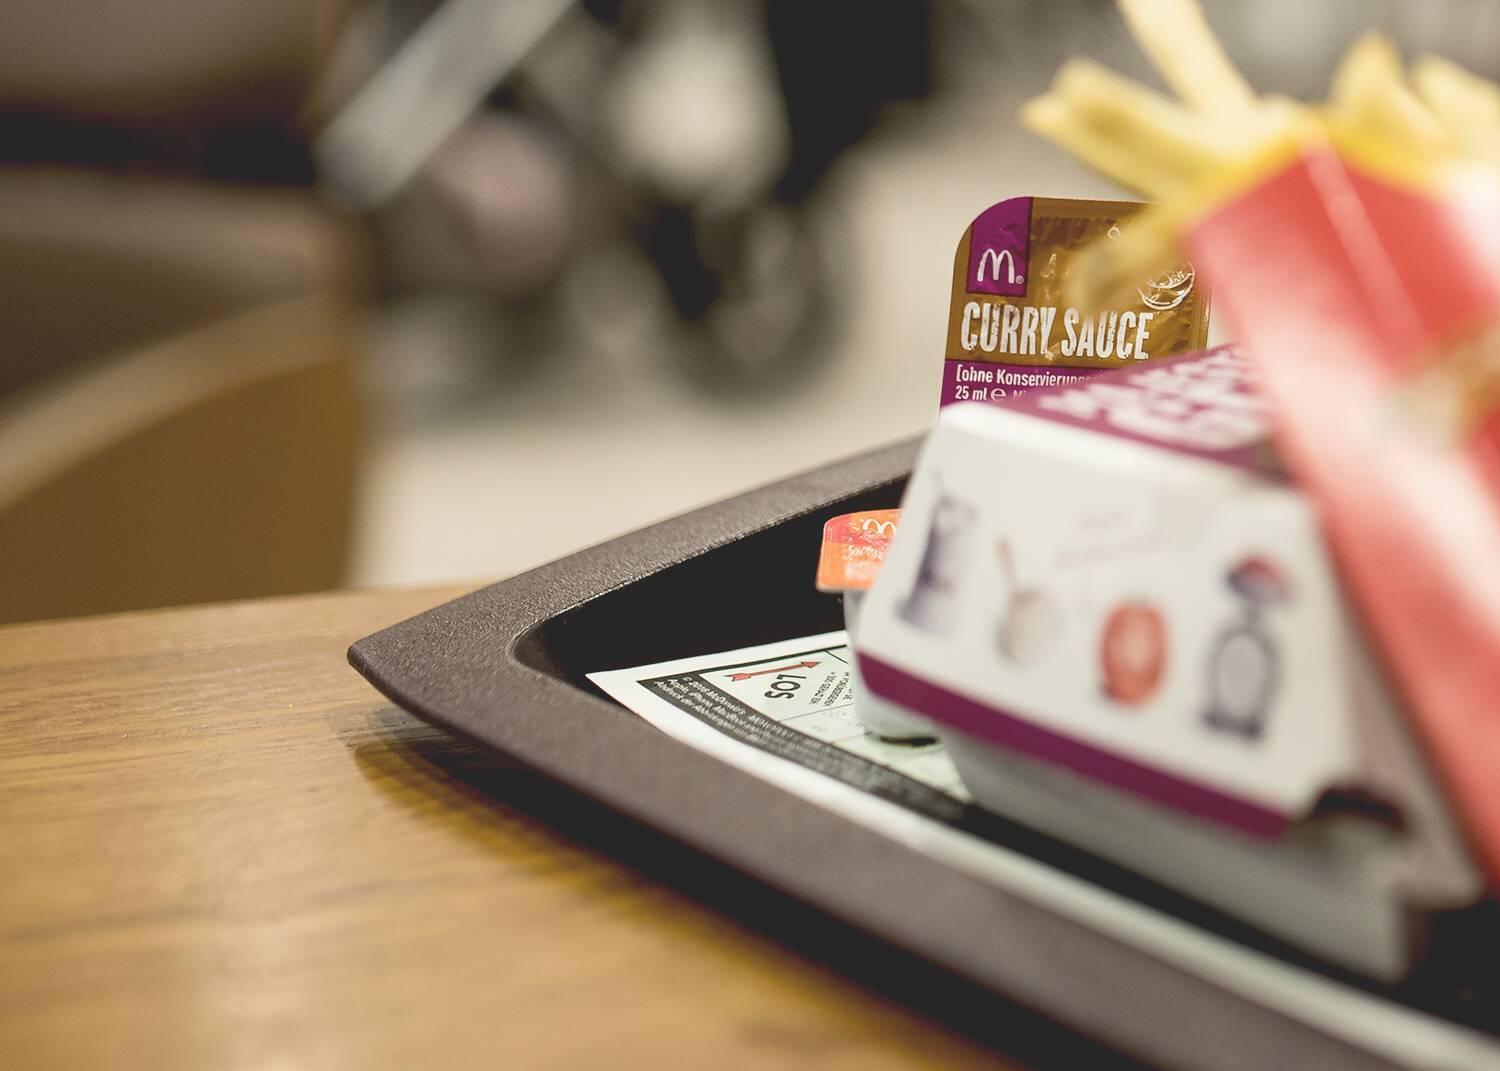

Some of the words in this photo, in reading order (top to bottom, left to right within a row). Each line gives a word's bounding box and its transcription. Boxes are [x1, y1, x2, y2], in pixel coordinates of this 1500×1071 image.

[960, 301, 1056, 355] CURRY
[1061, 307, 1153, 360] SAUCE
[955, 385, 969, 400] 25
[972, 387, 987, 401] ml
[764, 674, 807, 700] LOS
